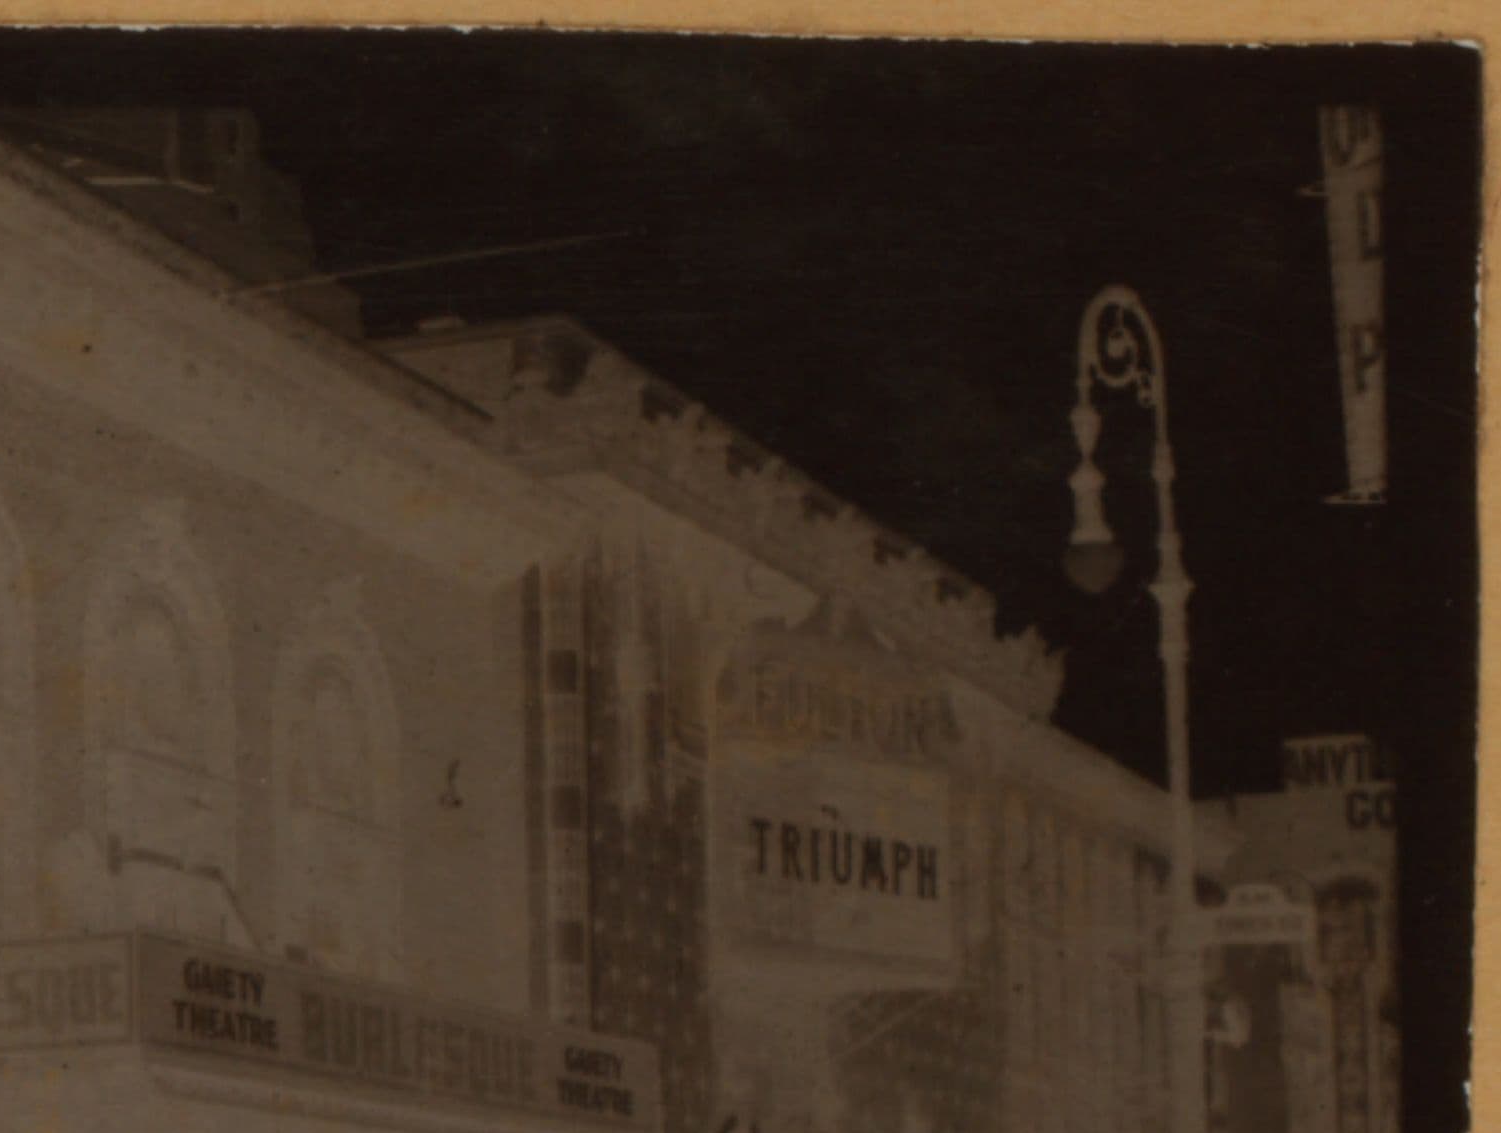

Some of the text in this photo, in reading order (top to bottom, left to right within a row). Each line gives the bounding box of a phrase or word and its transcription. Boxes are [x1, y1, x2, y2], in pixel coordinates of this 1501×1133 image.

[748, 815, 940, 902] TRIUMPH
[182, 956, 266, 1009] GAIETY
[171, 998, 280, 1053] THEATRE
[300, 989, 537, 1102] BURLESQUE
